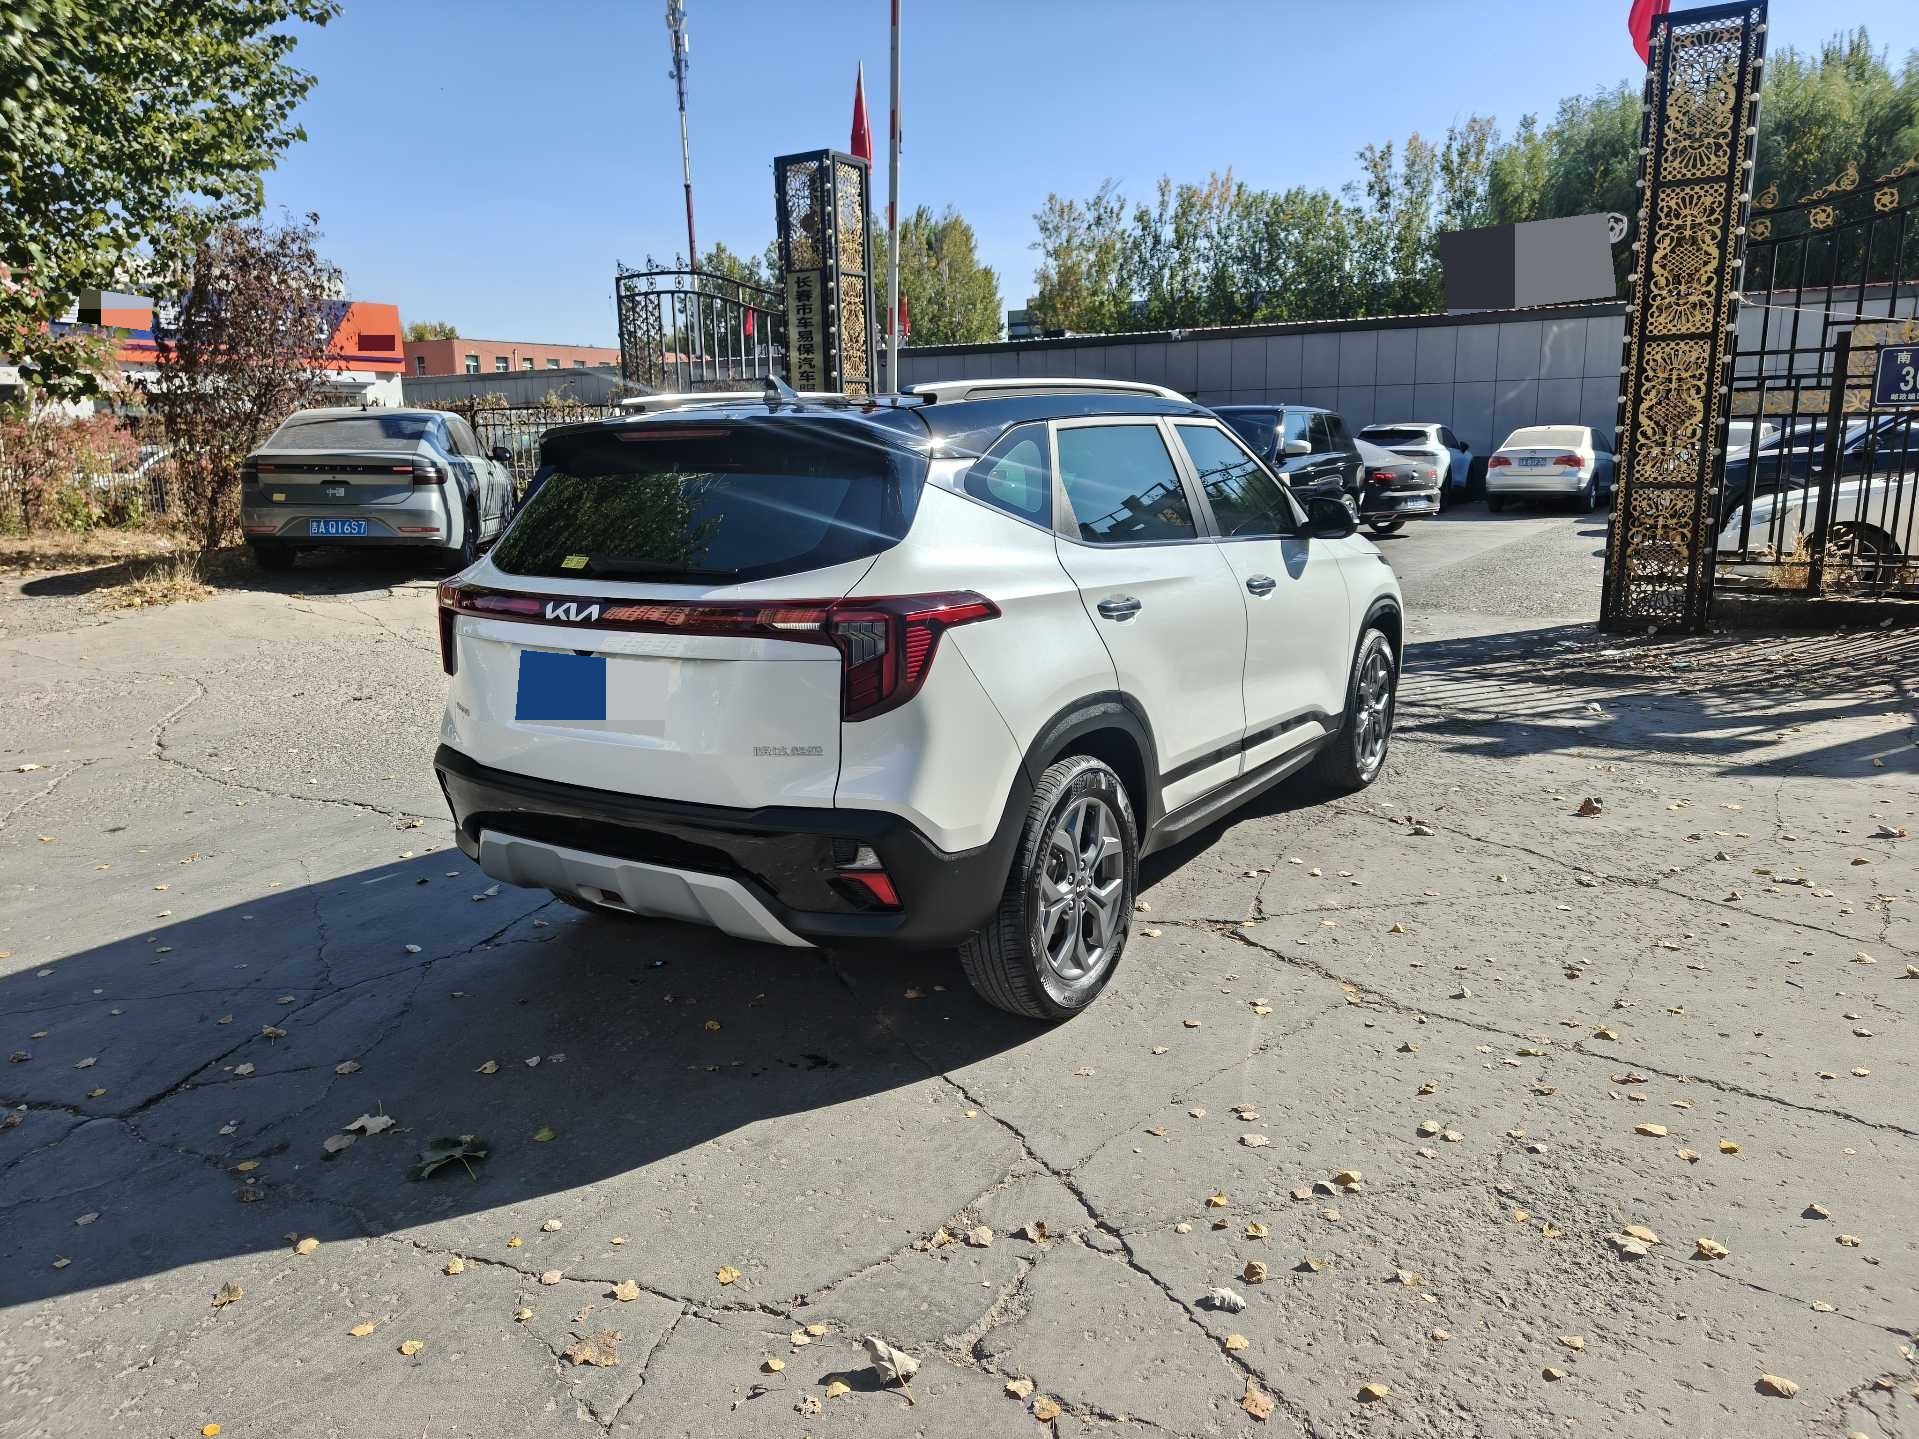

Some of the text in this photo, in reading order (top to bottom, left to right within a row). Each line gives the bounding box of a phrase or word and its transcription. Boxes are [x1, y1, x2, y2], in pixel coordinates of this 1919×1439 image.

[1897, 351, 1912, 364] 南
[1899, 366, 1919, 391] 3
[545, 601, 600, 622] KIA
